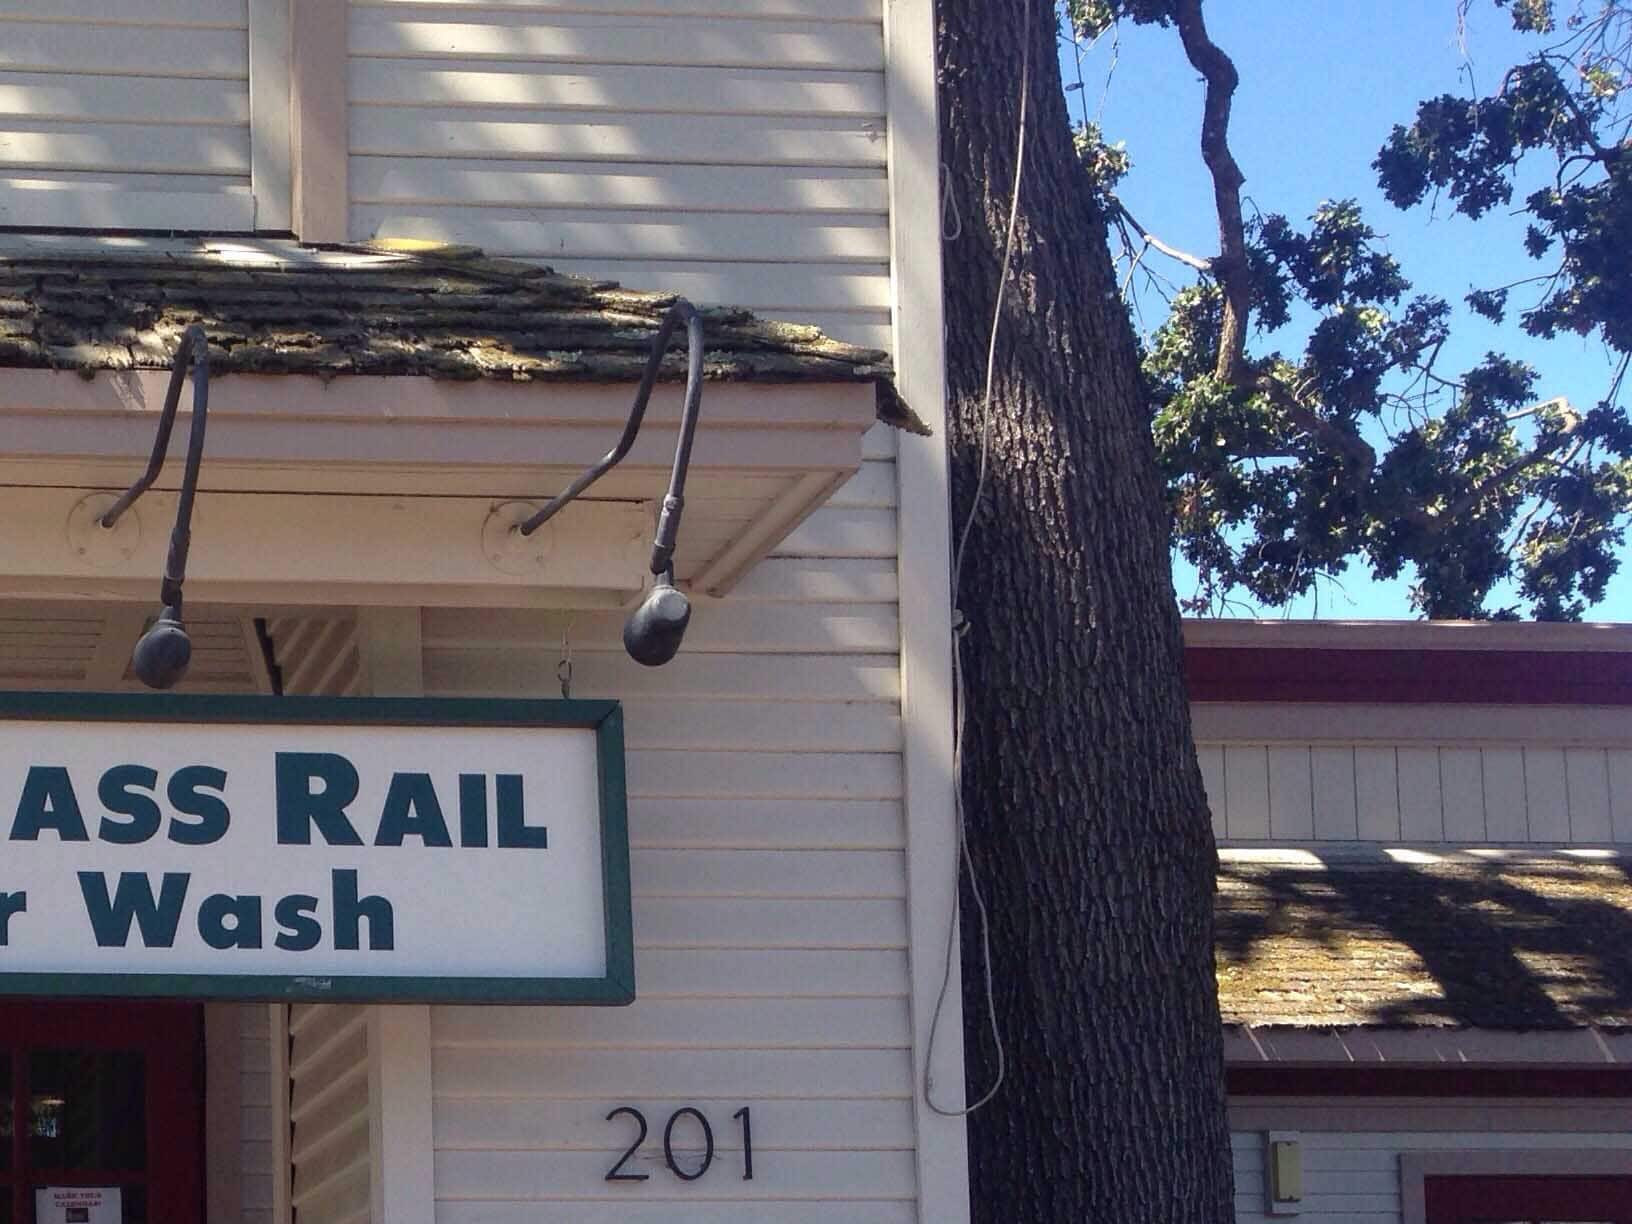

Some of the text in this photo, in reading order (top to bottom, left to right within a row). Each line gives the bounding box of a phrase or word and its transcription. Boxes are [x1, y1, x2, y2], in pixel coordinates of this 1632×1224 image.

[275, 752, 547, 849] RAIL
[77, 869, 394, 951] Wash
[605, 1107, 752, 1181] 201
